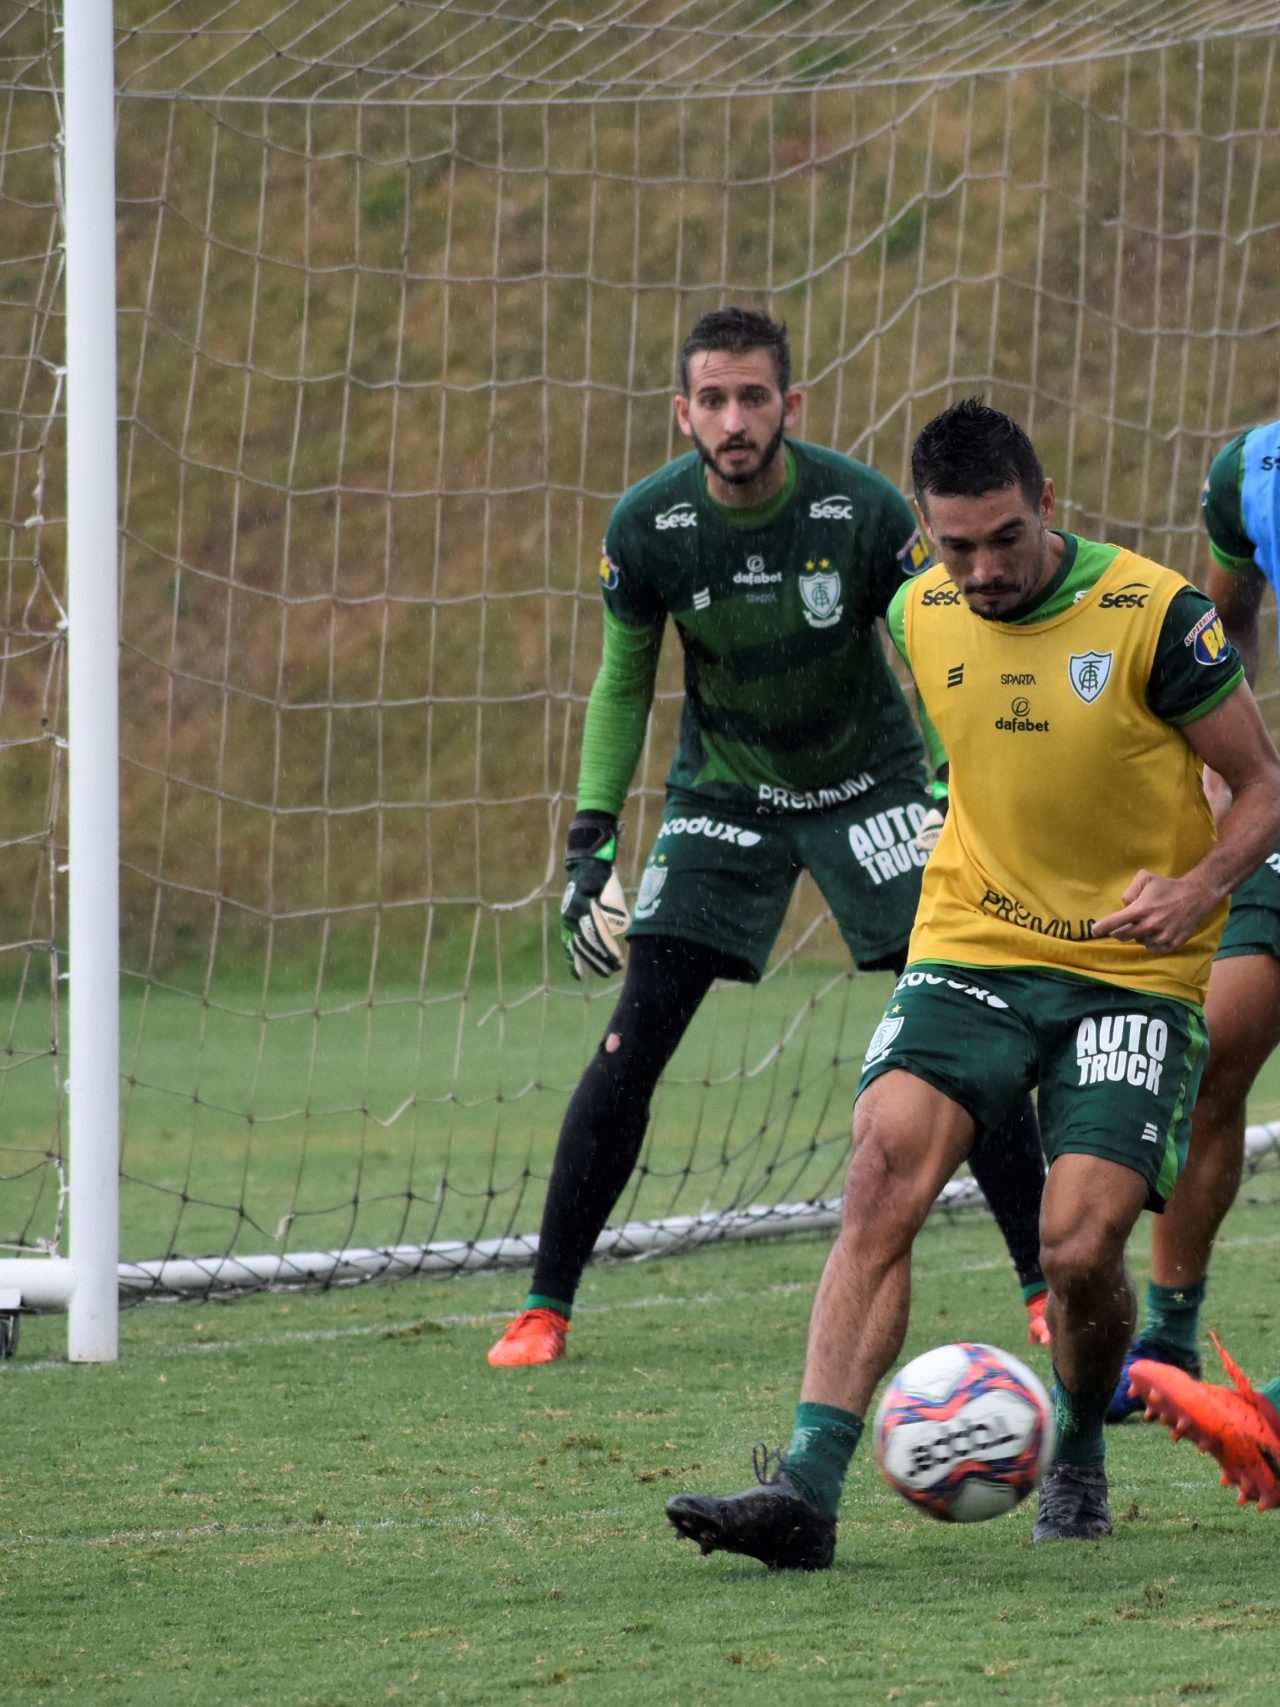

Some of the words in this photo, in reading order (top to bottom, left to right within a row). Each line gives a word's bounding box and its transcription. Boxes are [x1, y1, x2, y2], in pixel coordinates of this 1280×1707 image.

[733, 571, 783, 587] dafabet
[1098, 591, 1150, 609] Sesc
[1000, 673, 1037, 686] SPARTA
[995, 716, 1050, 734] dafabet
[848, 802, 931, 862] AUTO
[860, 837, 936, 886] TRUC
[1076, 1013, 1168, 1063] AUTO
[1076, 1051, 1163, 1096] TRUCK
